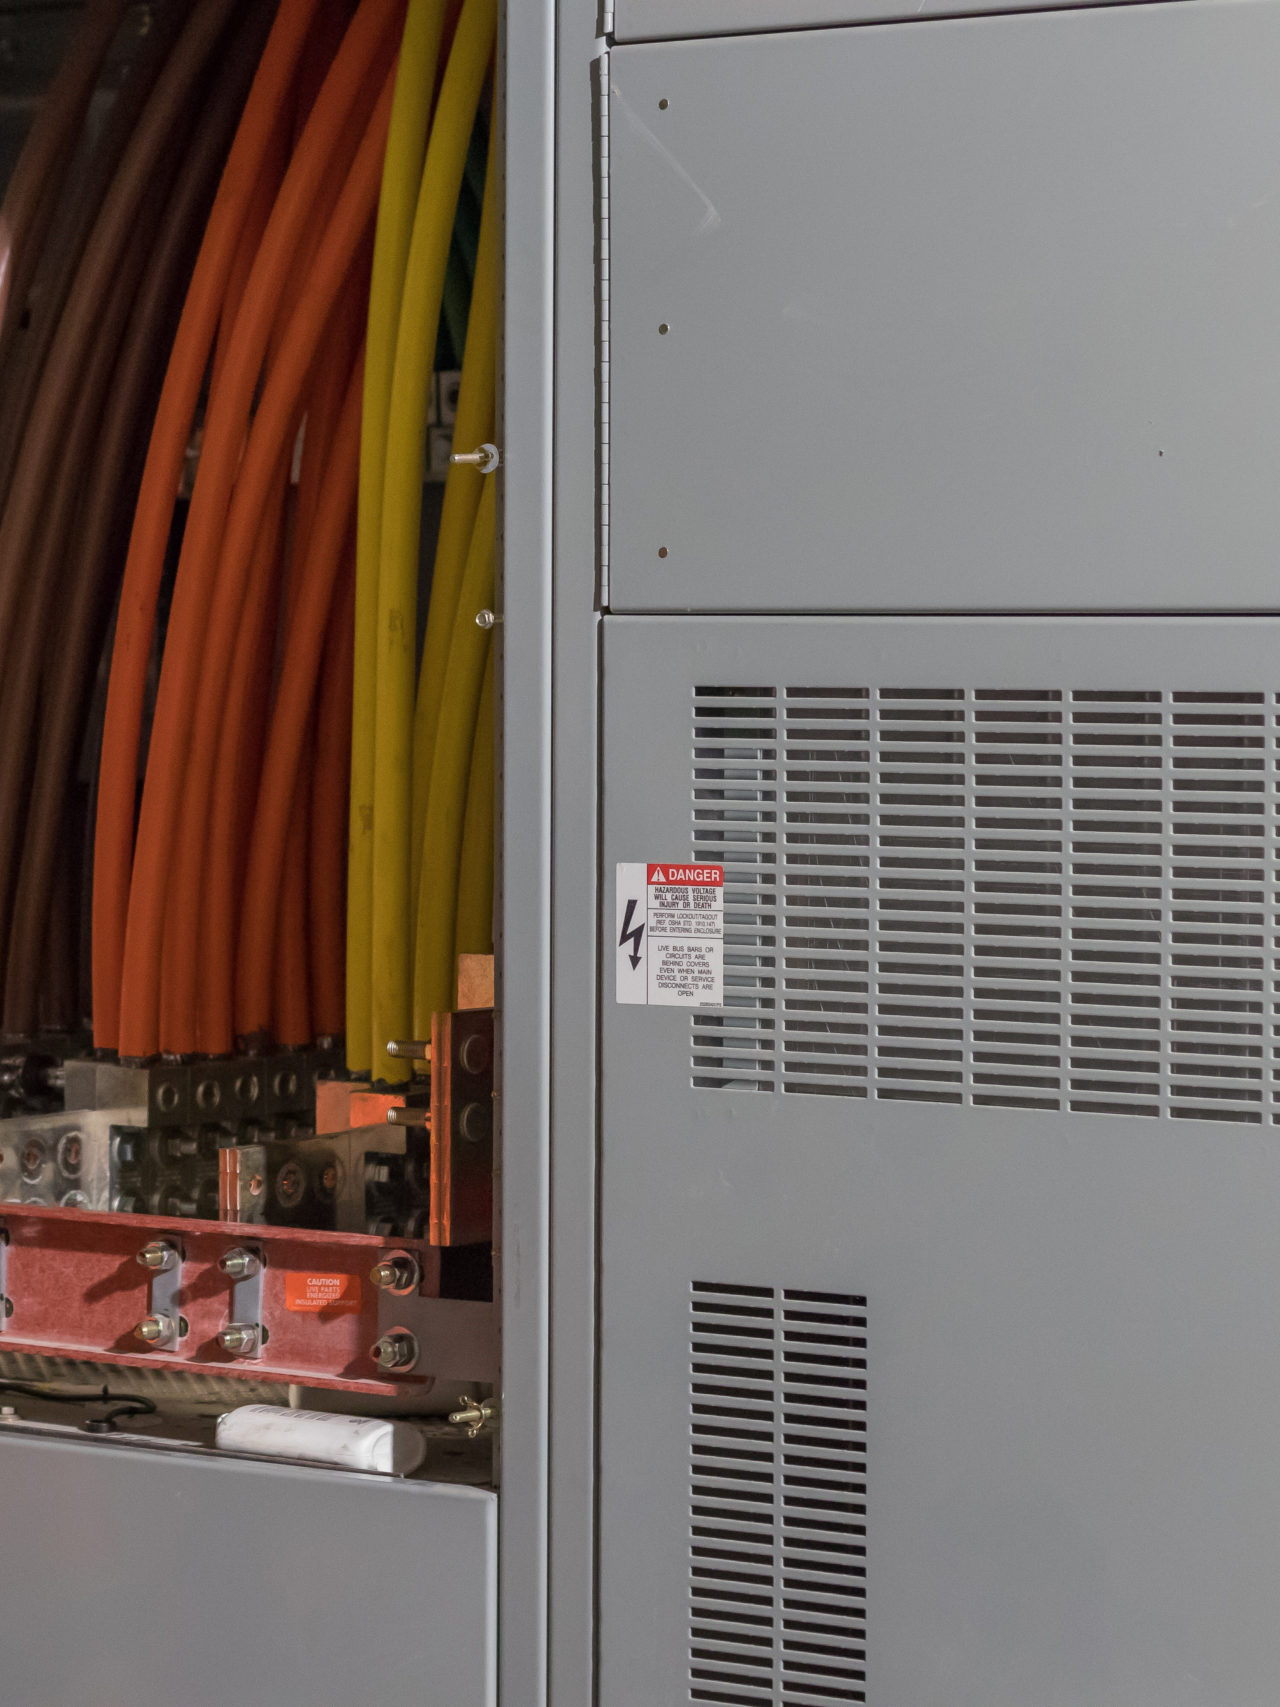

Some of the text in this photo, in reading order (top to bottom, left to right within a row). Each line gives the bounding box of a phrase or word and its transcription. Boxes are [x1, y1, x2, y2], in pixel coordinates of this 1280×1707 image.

[668, 869, 720, 882] DANGER
[671, 894, 690, 902] CAUSE
[659, 901, 680, 909] INJURY
[682, 901, 691, 909] OR
[669, 926, 693, 934] ENTERING
[658, 982, 699, 990] DISCONNECTS
